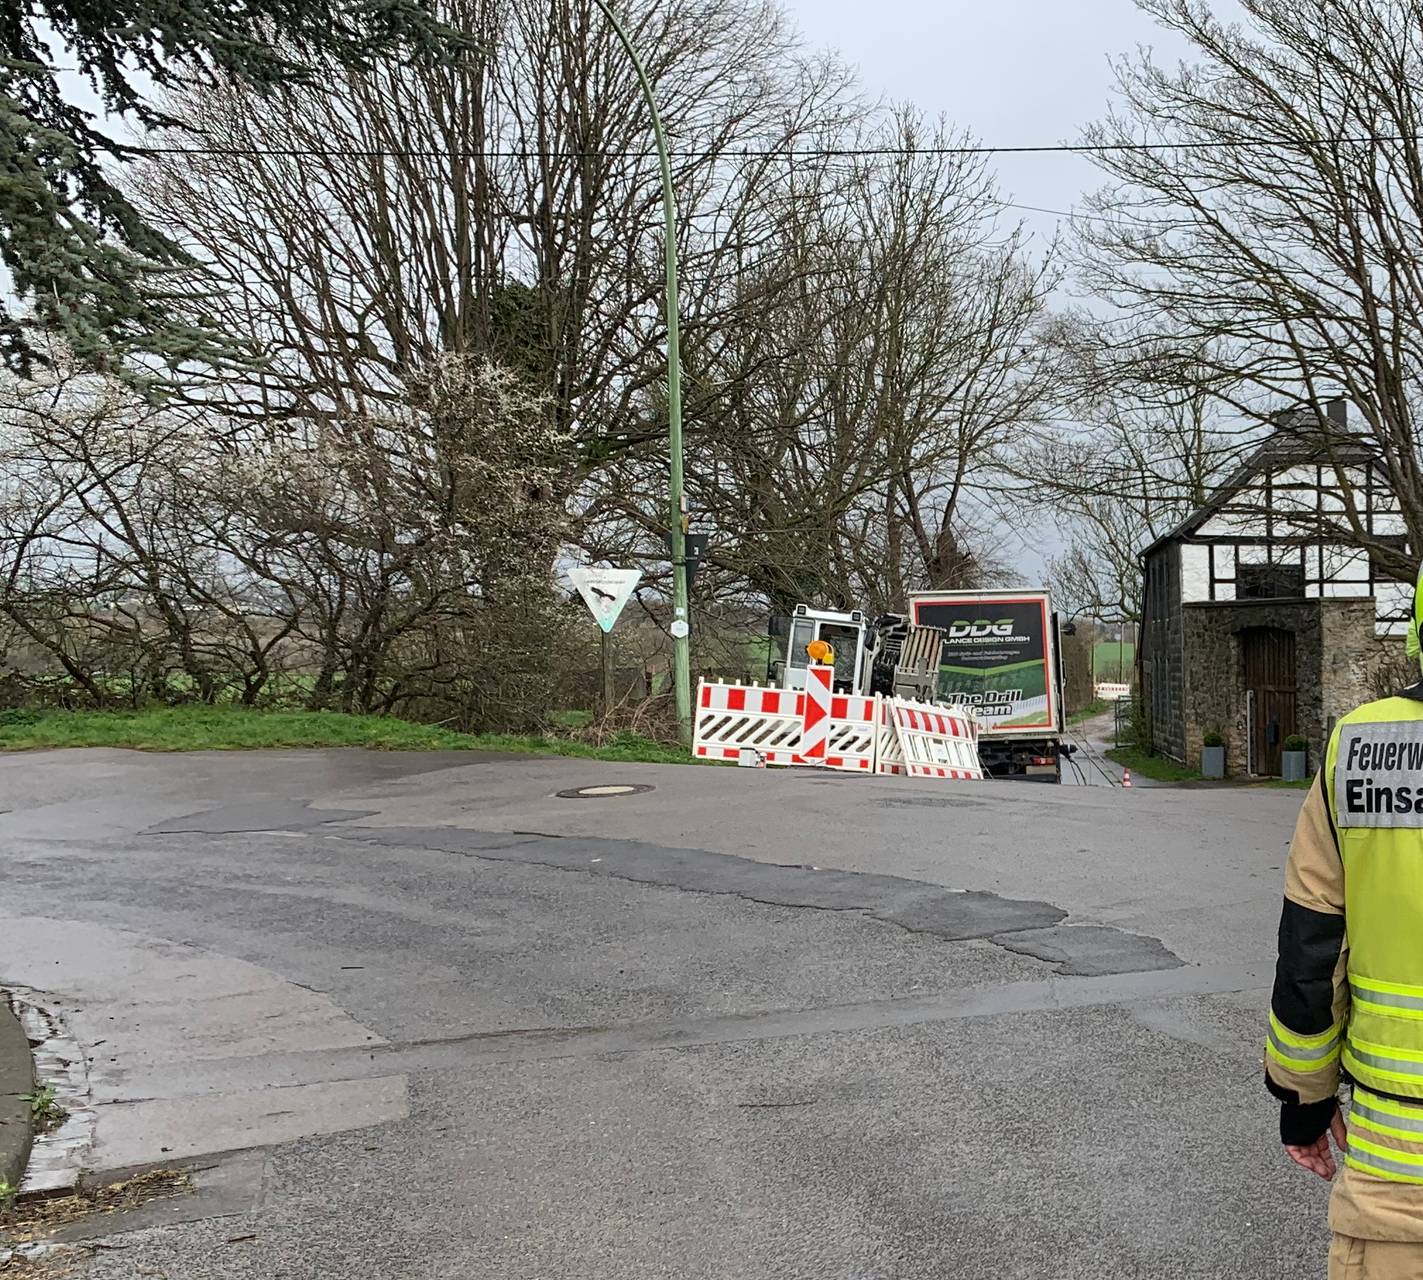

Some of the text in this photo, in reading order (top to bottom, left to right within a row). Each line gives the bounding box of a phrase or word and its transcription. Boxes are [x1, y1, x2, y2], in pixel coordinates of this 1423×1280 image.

[949, 619, 1015, 637] DDG
[943, 637, 972, 645] LANCE
[949, 689, 1023, 704] The Drill
[963, 704, 1012, 716] Team
